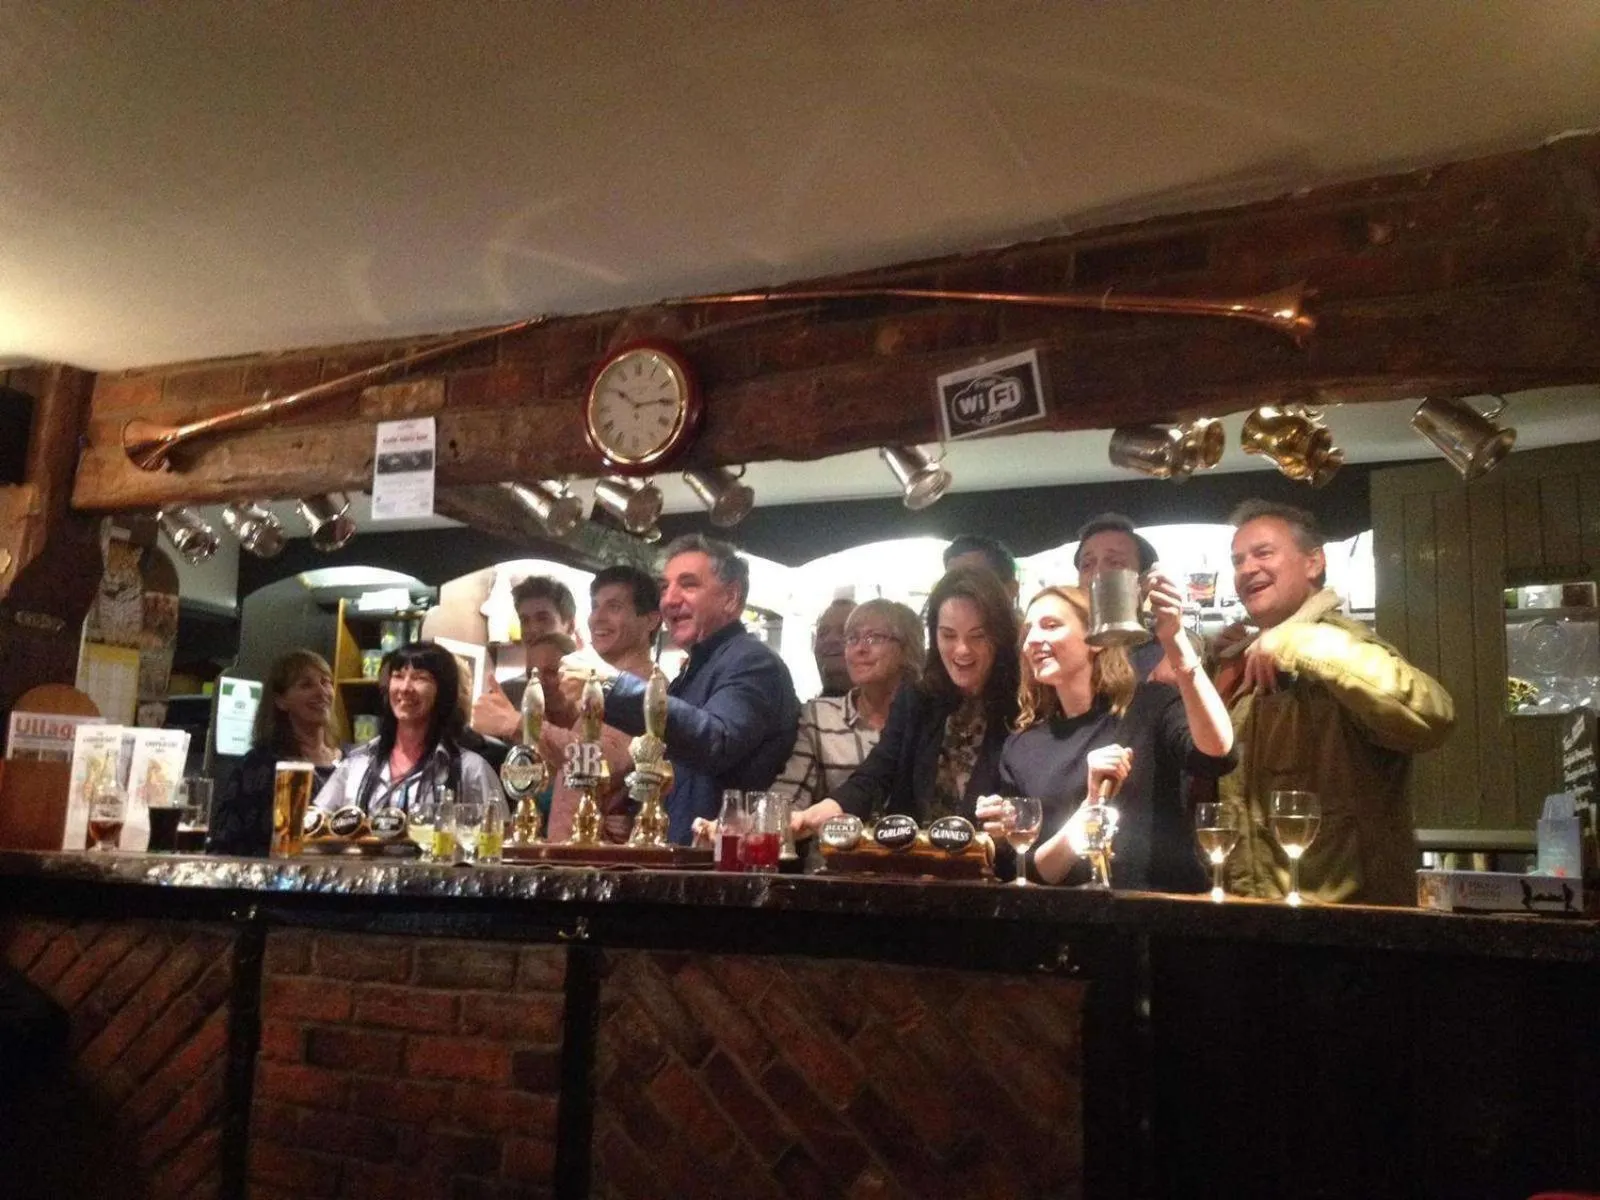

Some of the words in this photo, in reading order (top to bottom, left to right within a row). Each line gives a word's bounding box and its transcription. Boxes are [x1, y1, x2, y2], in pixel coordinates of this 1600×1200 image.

[15, 717, 75, 740] Ullag
[878, 827, 911, 839] CARLING
[931, 827, 970, 841] GUINNESS
